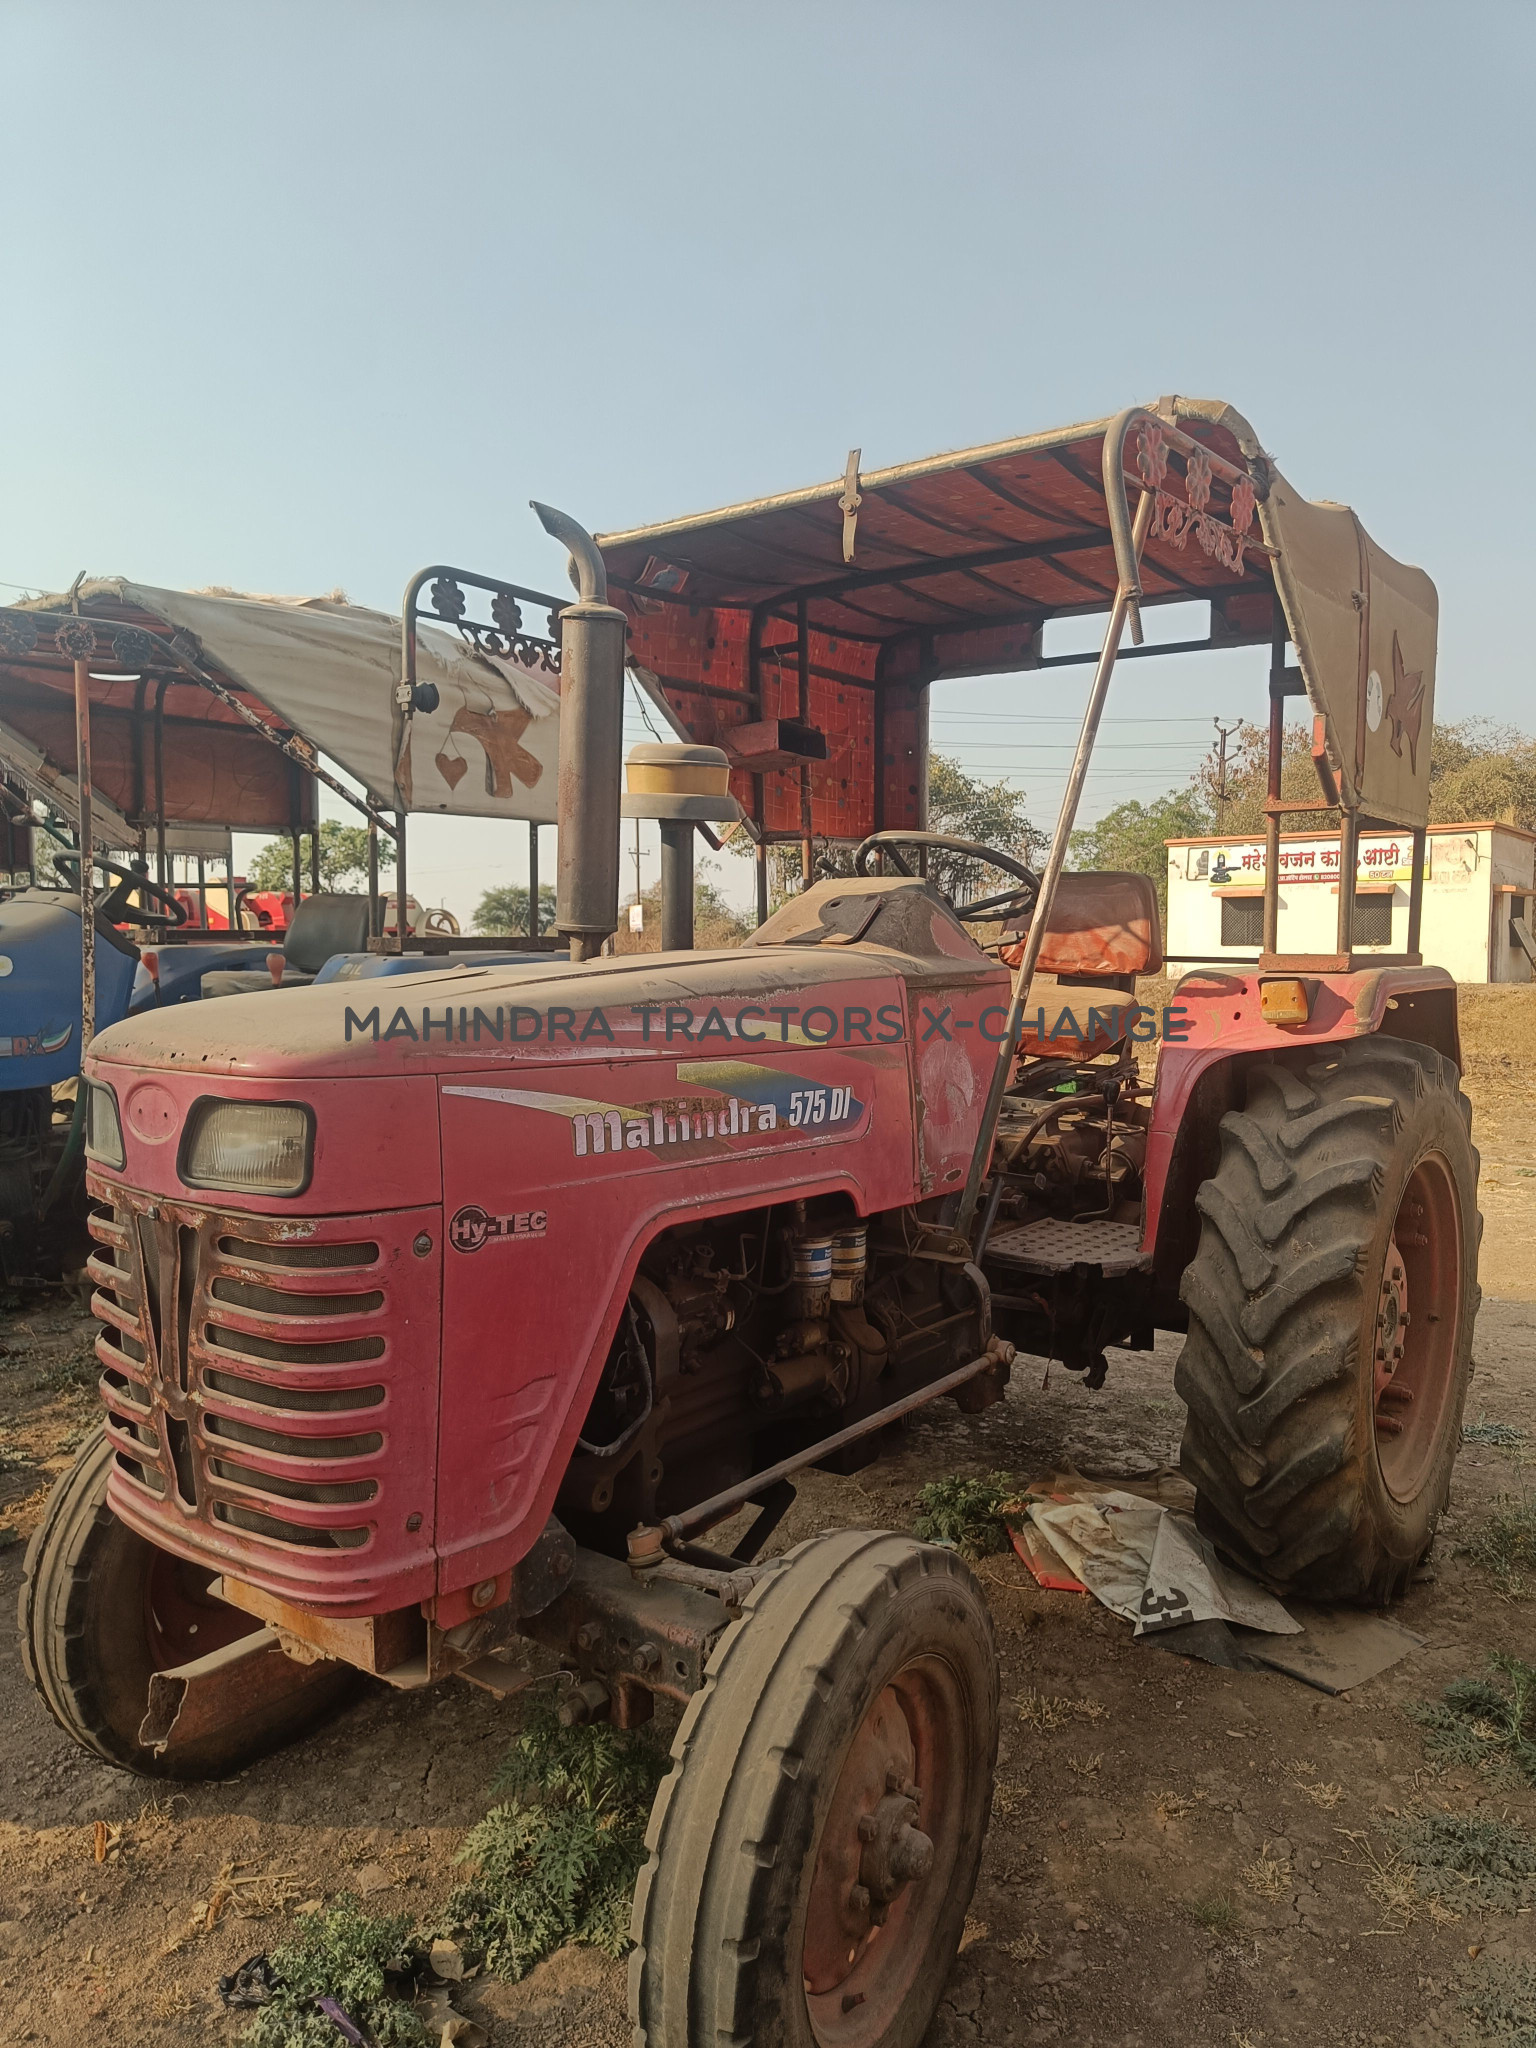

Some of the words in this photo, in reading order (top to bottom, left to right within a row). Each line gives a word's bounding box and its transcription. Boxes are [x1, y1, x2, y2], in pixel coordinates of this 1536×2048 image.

[1278, 851, 1316, 869] वजन
[1369, 871, 1380, 879] 50
[788, 1089, 826, 1127] 575
[829, 1086, 852, 1121] DI
